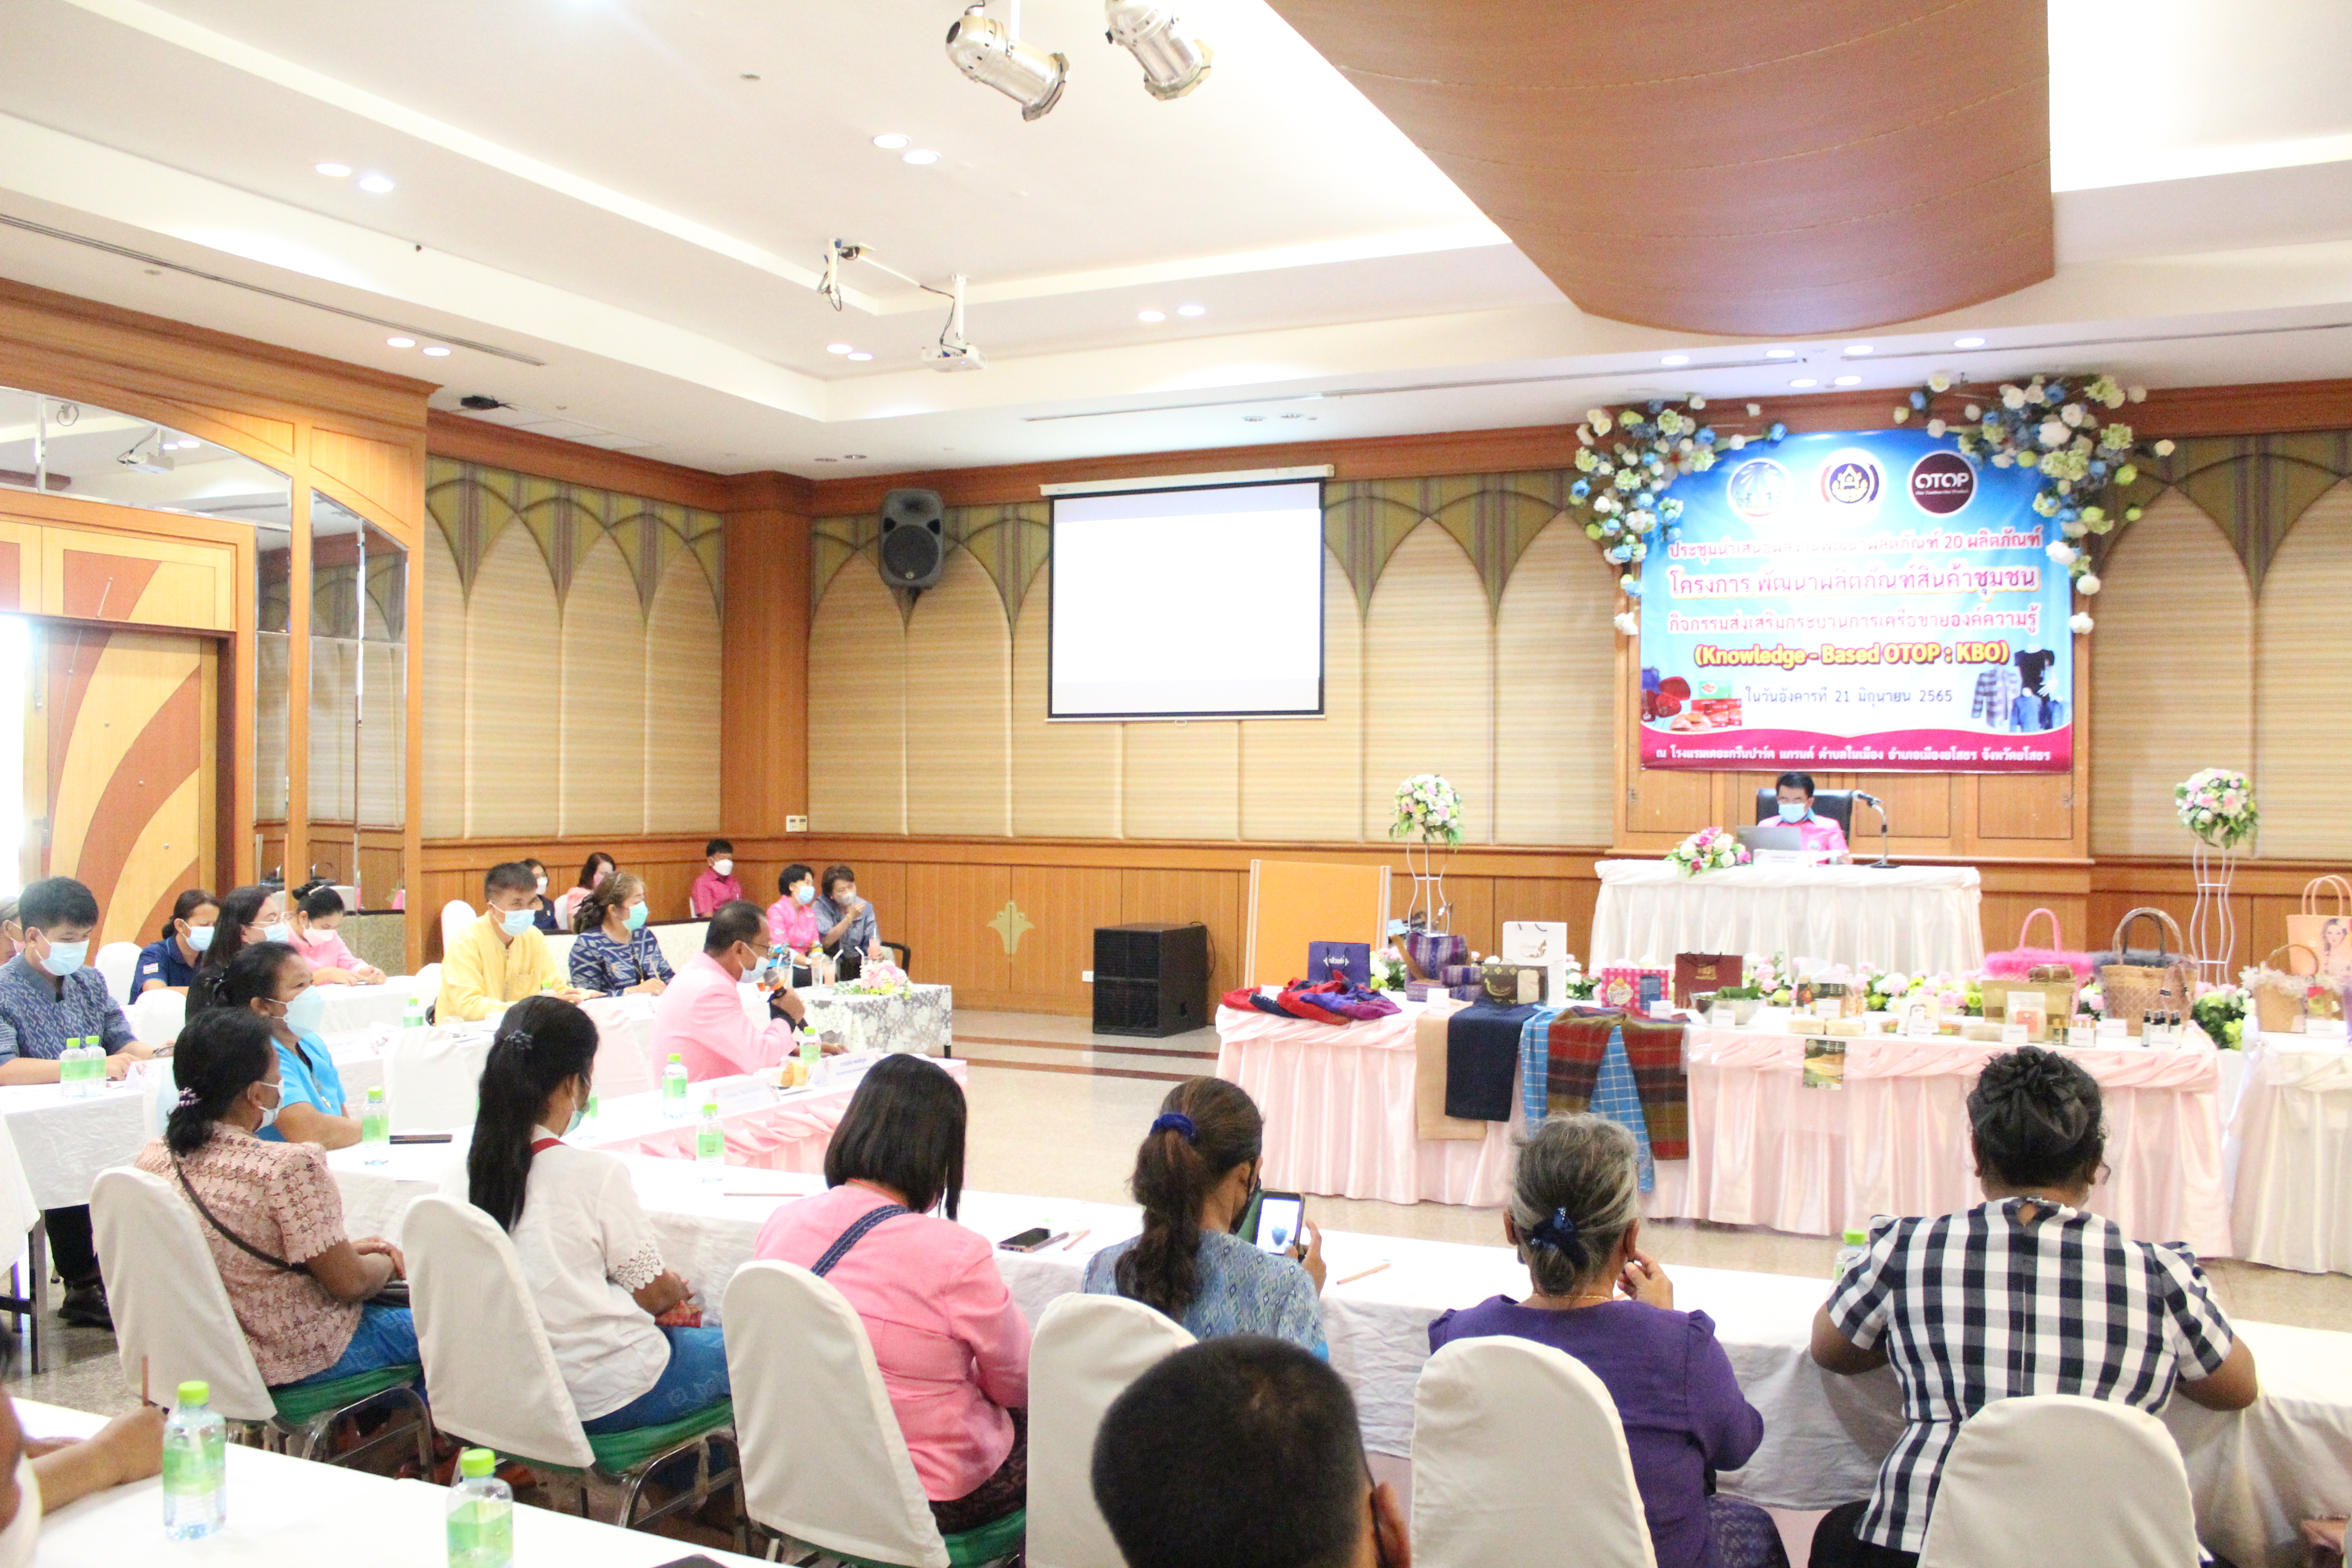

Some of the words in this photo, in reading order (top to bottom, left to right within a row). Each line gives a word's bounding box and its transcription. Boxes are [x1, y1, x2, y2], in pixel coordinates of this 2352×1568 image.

[1915, 472, 1970, 489] OTOP
[1944, 535, 1963, 549] 20
[1967, 527, 2041, 549] ผลิตภัณฑ์
[1669, 570, 1750, 594] โครงการ
[1758, 563, 2035, 596] พัฒนาผลิตภัณฑ์สินค้าชุมชน
[1670, 605, 2038, 633] กิจกรรมส่งเสริมกระบวนการเครือข่ายองค์ความรู้
[1695, 644, 1807, 671] (Knowledge
[1821, 642, 1881, 665] Based
[1883, 642, 1941, 665] OTOP
[1944, 647, 1953, 663] :
[1955, 640, 2010, 665] KBO)
[1745, 683, 1827, 702] ในวันอังคารที่
[1835, 691, 1850, 702] 21
[1858, 687, 1911, 708] มิถุนายน
[1920, 690, 1953, 702] 2565
[1656, 749, 1667, 758] ณ
[1779, 745, 1815, 760] แกรนด์
[1818, 745, 1884, 760] ตำบลในเมือง
[1888, 746, 1977, 760] อำเภอเมืองยโสธร
[1981, 746, 2051, 761] จังหวัดยโสธร
